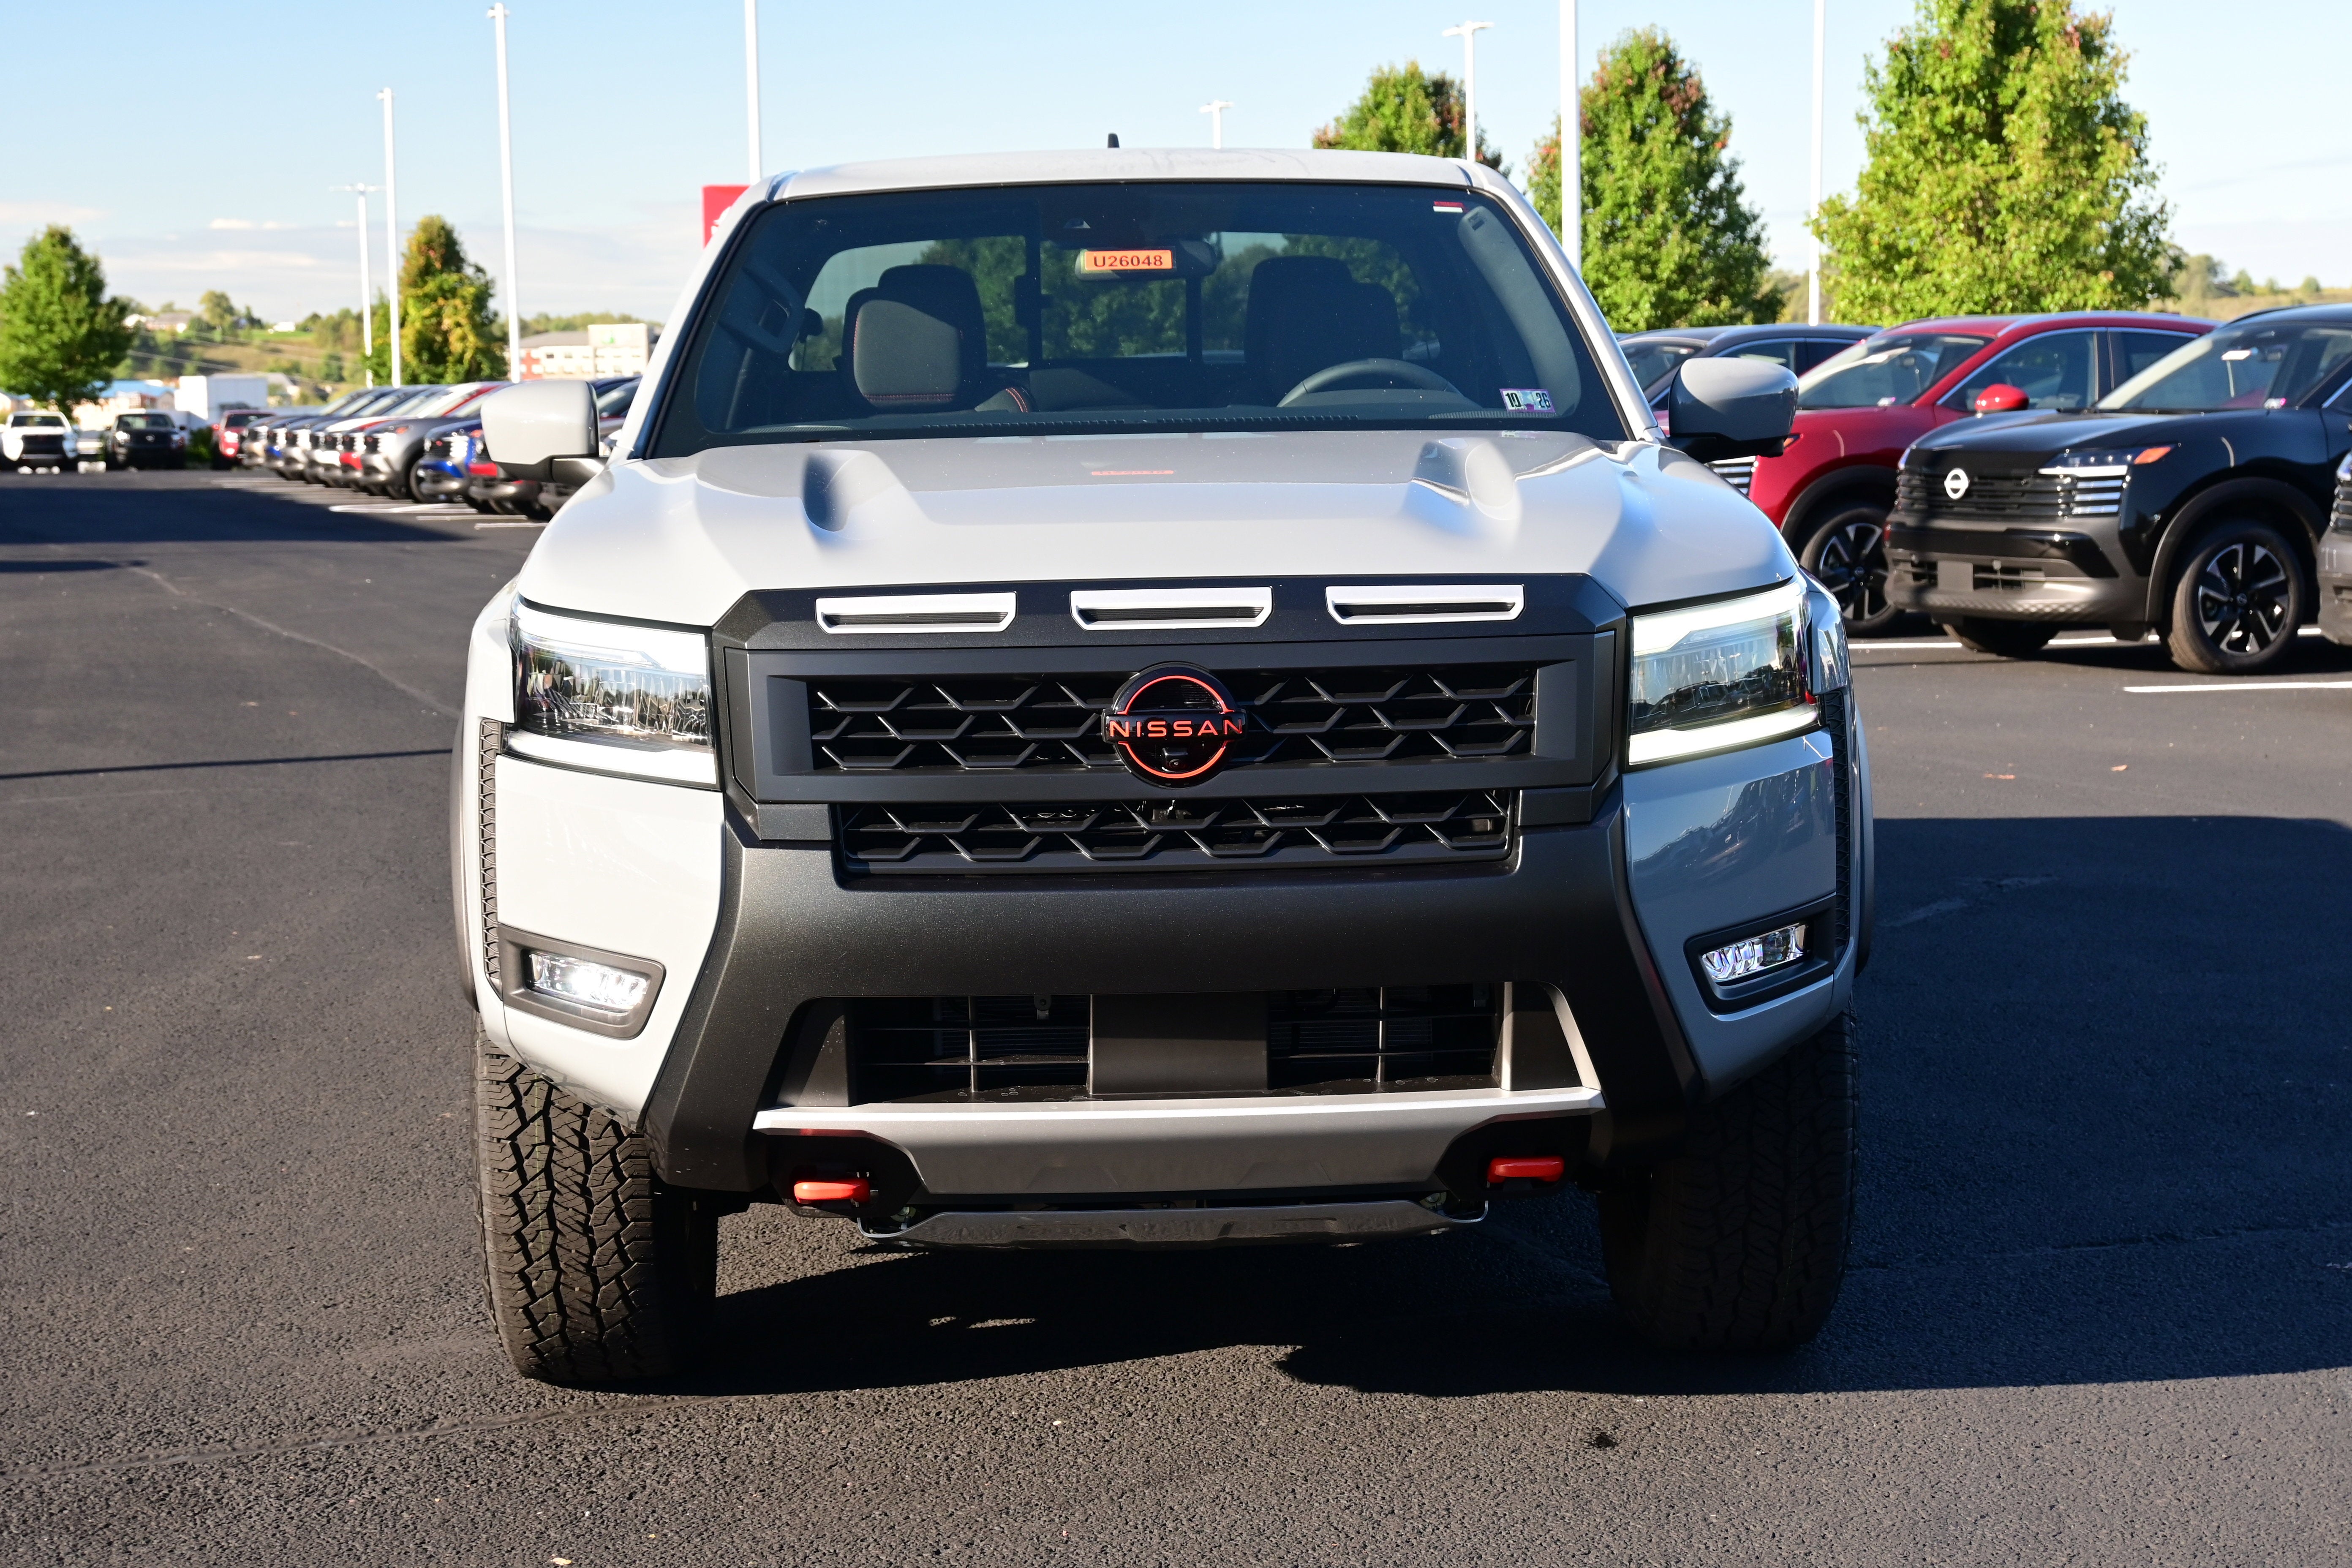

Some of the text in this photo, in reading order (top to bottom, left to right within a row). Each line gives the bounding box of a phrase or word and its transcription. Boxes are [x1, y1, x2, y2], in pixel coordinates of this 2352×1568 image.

[1093, 255, 1163, 267] U26048
[1505, 392, 1551, 408] 10 26
[1110, 719, 1242, 737] NISSAN
